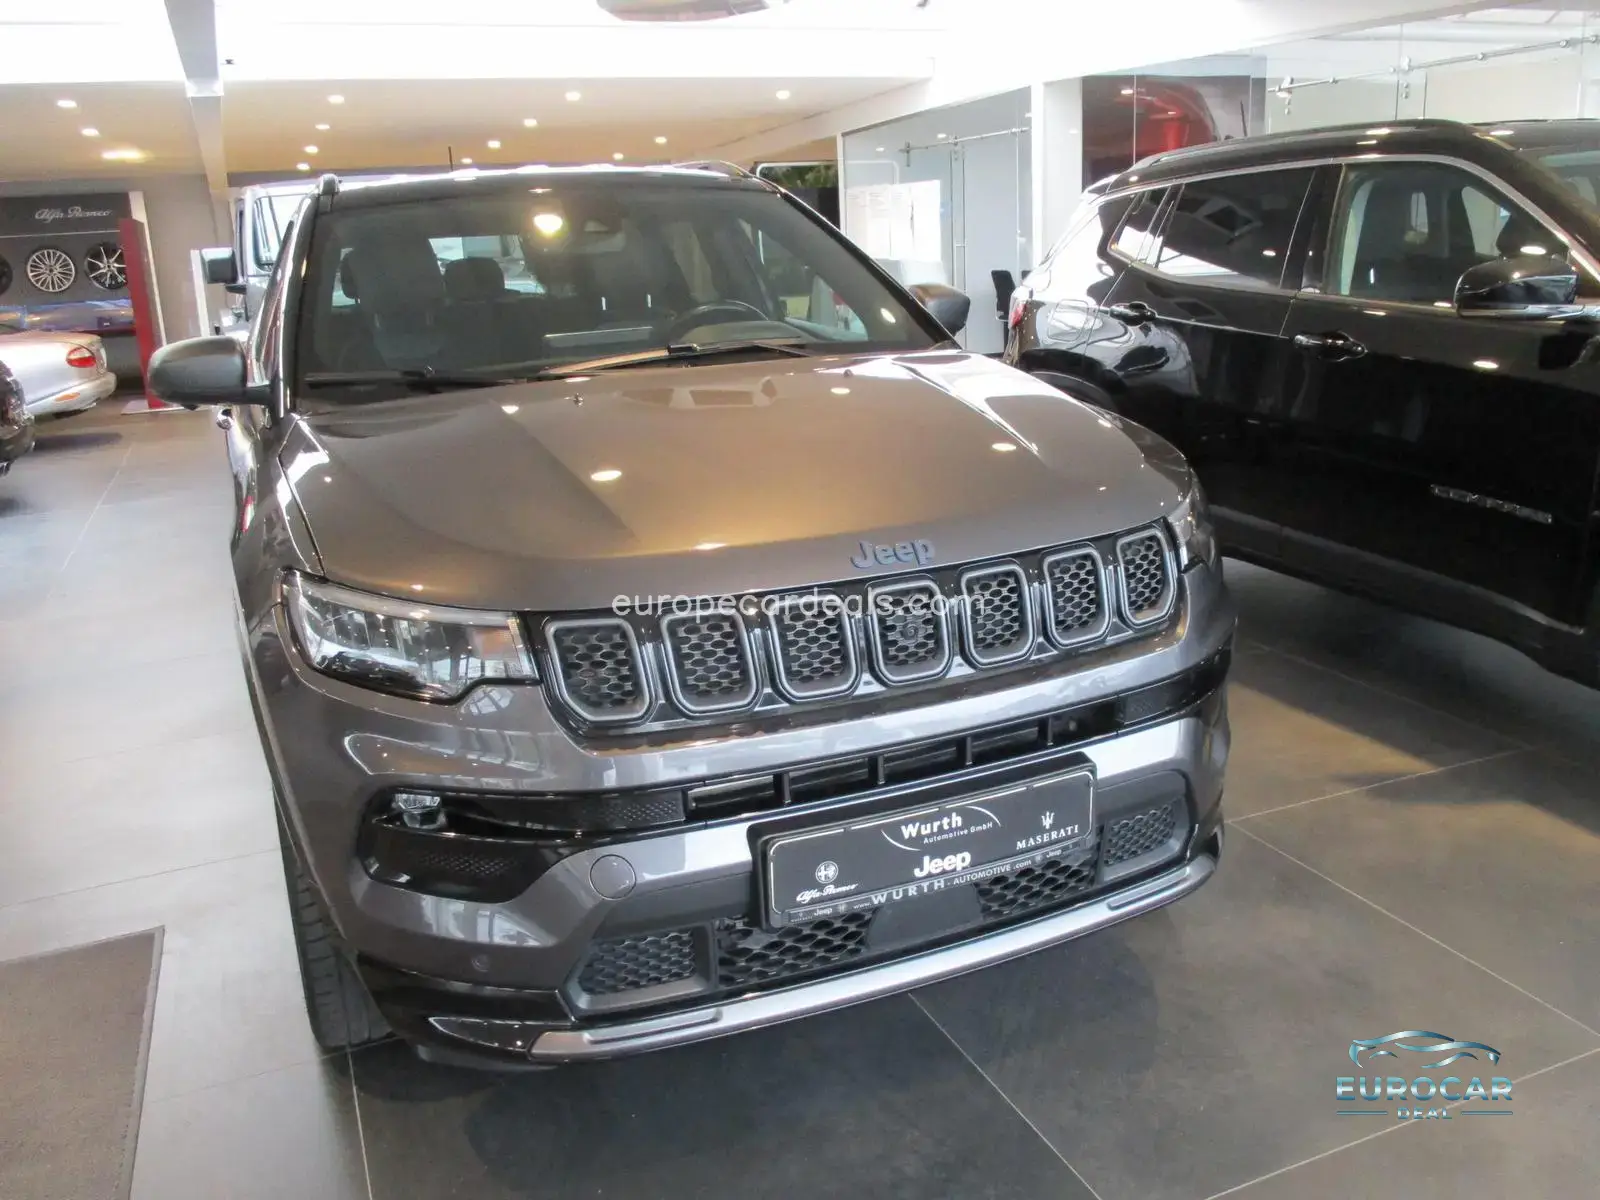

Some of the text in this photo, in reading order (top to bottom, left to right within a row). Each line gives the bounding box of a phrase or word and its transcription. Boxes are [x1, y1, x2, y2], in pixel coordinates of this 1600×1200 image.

[34, 206, 113, 223] Alfa Romeo
[850, 538, 936, 568] Jeep
[901, 812, 963, 839] Wurth
[923, 821, 993, 844] Automotive GmbH
[1016, 824, 1079, 850] MASERATI
[913, 851, 971, 878] Jeep
[796, 888, 821, 904] Alfa
